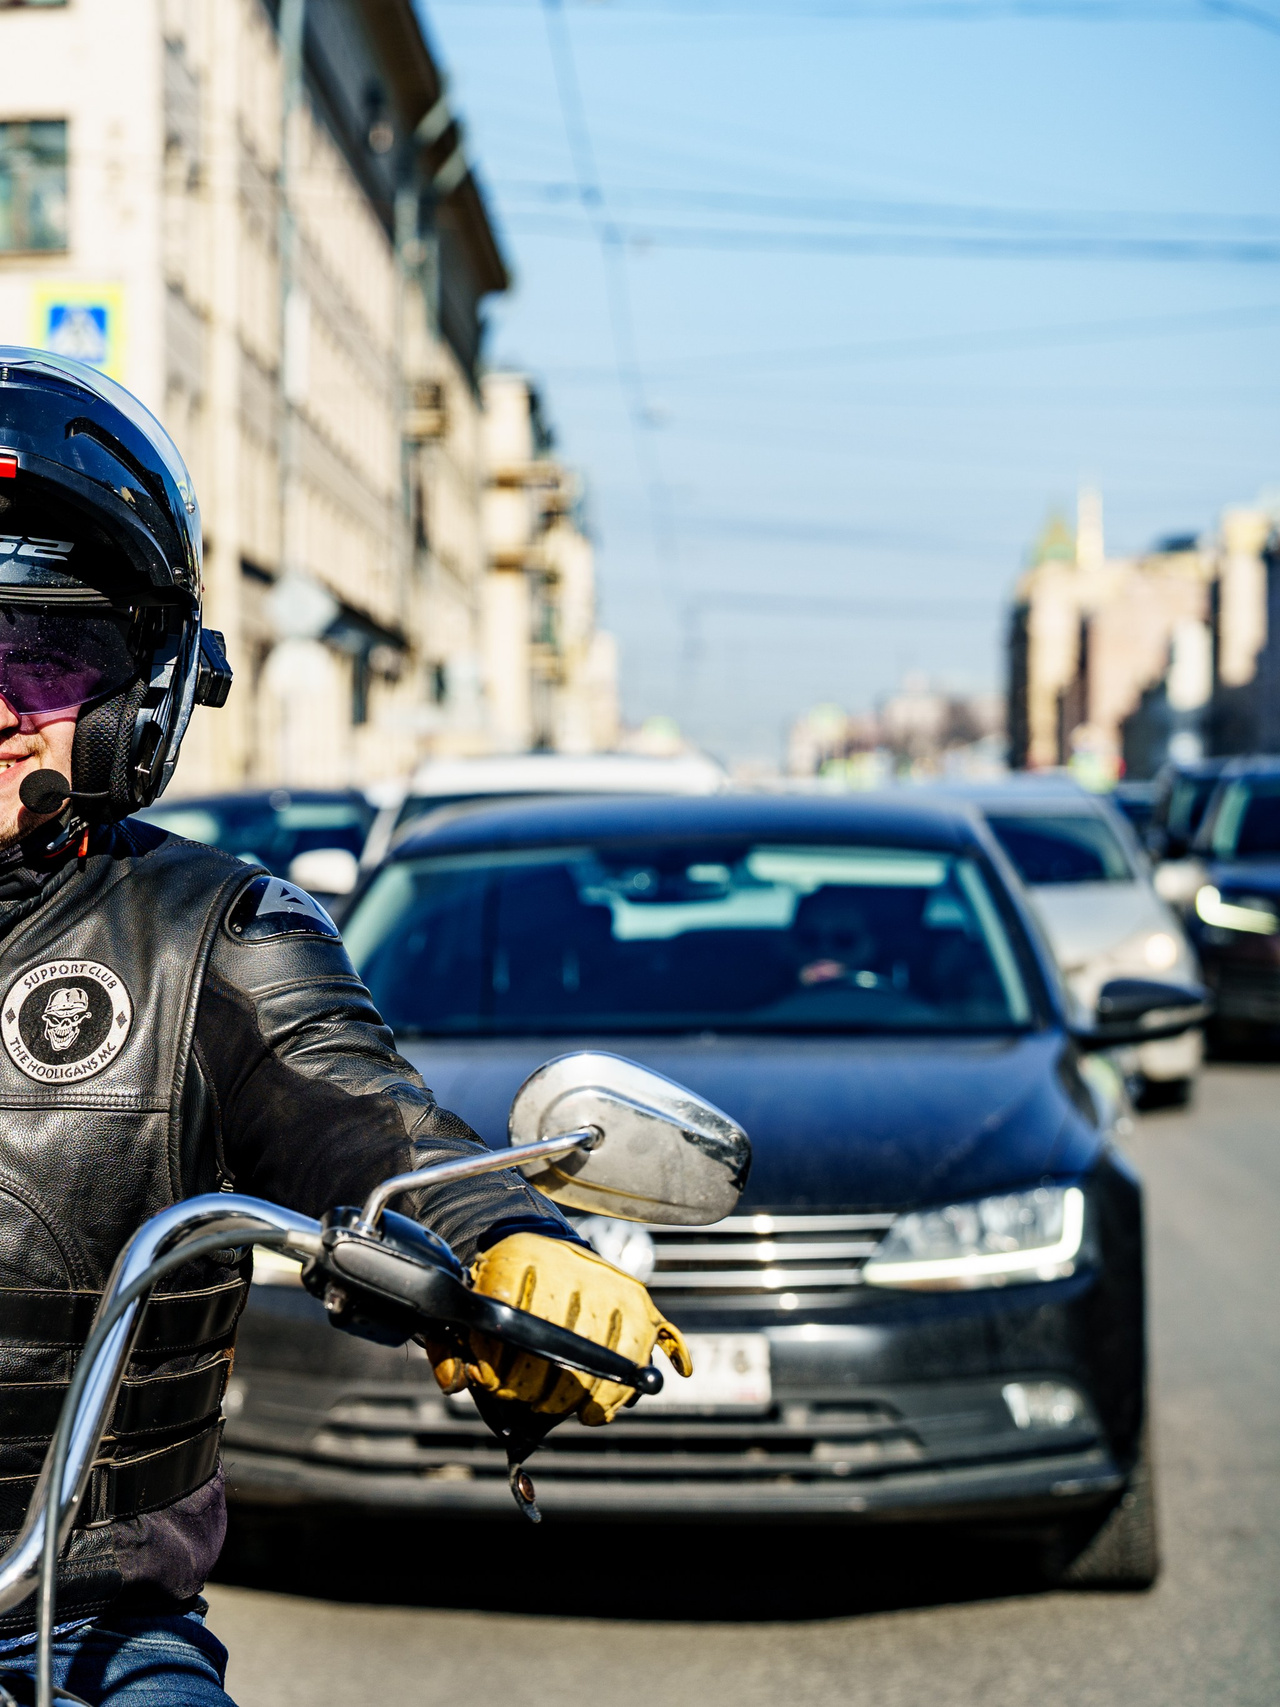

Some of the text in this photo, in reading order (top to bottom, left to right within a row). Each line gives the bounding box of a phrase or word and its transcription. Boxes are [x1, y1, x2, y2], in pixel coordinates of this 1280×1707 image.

[23, 964, 118, 990] SUPPORT CLUB
[9, 1037, 117, 1079] THE HOOLIGANS MC
